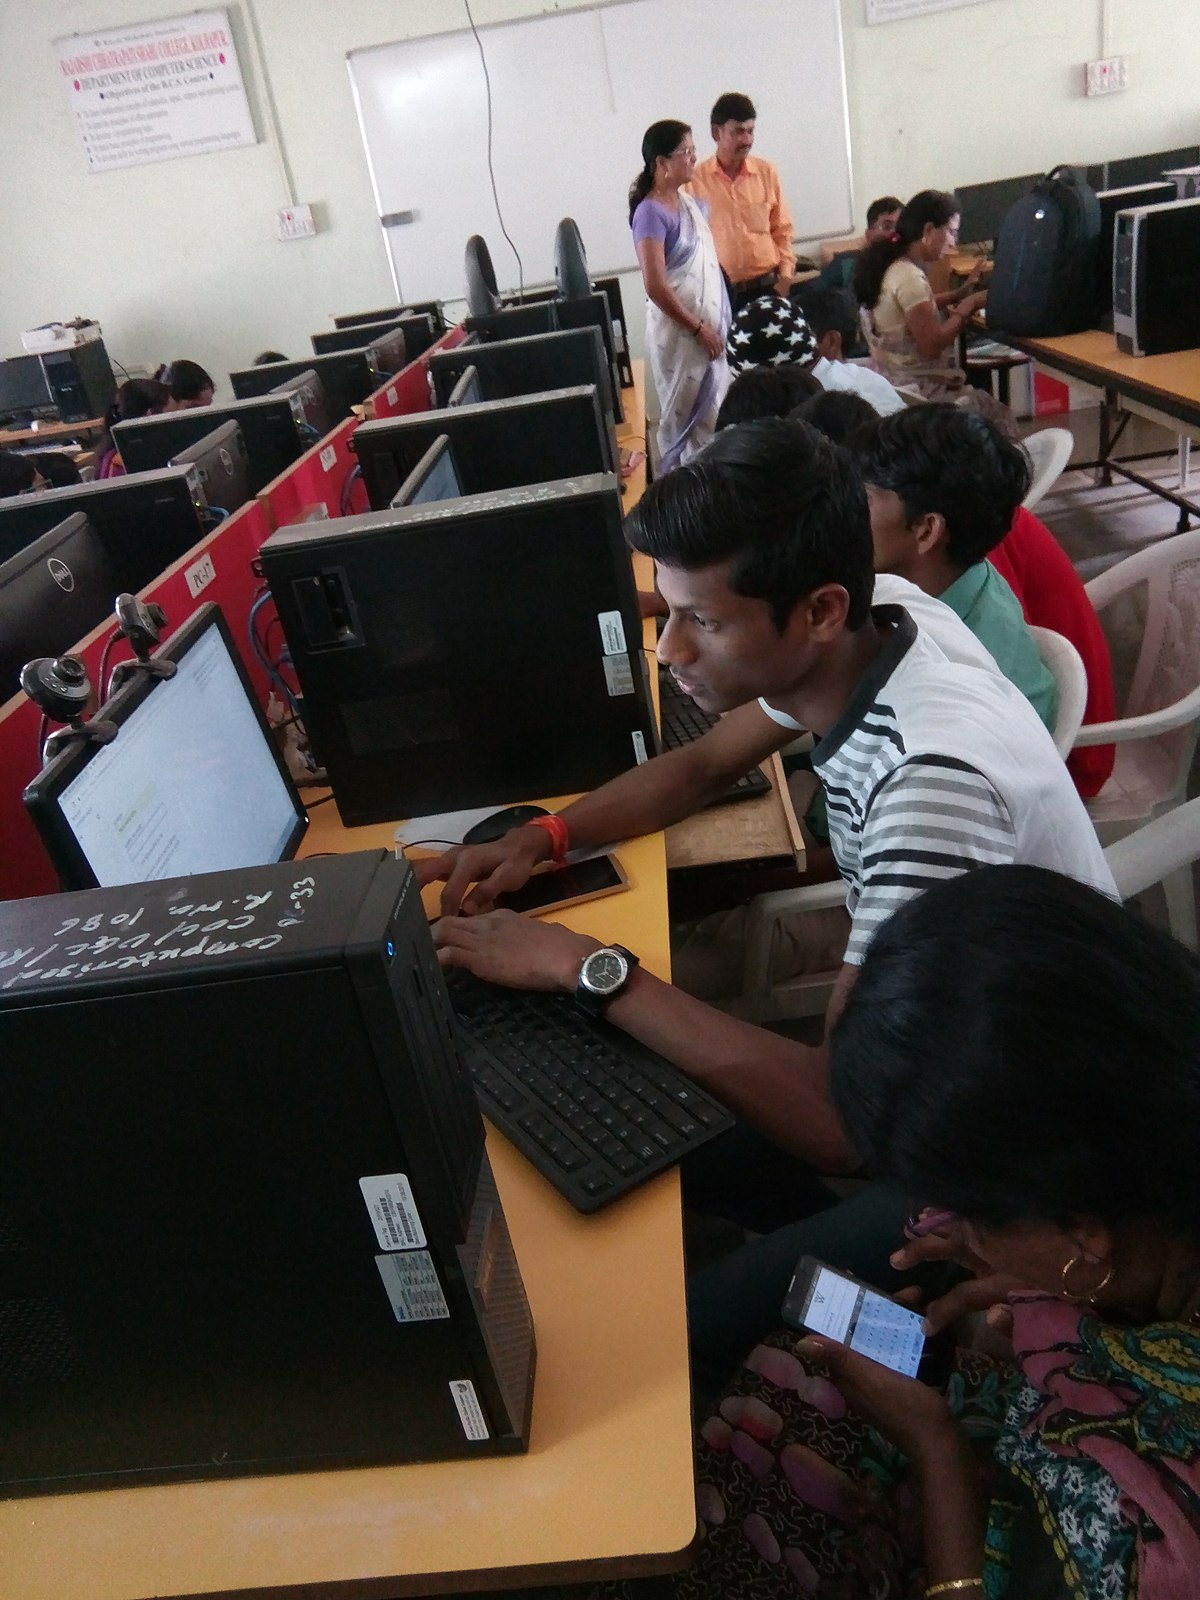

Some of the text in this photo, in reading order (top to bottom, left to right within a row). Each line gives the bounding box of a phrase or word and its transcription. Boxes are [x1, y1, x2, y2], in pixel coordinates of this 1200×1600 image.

[81, 70, 131, 91] DEPARTMENT
[142, 61, 185, 81] COMPUTER
[186, 54, 218, 71] SCIENCE
[54, 567, 70, 583] DELL
[54, 907, 145, 937] 1086
